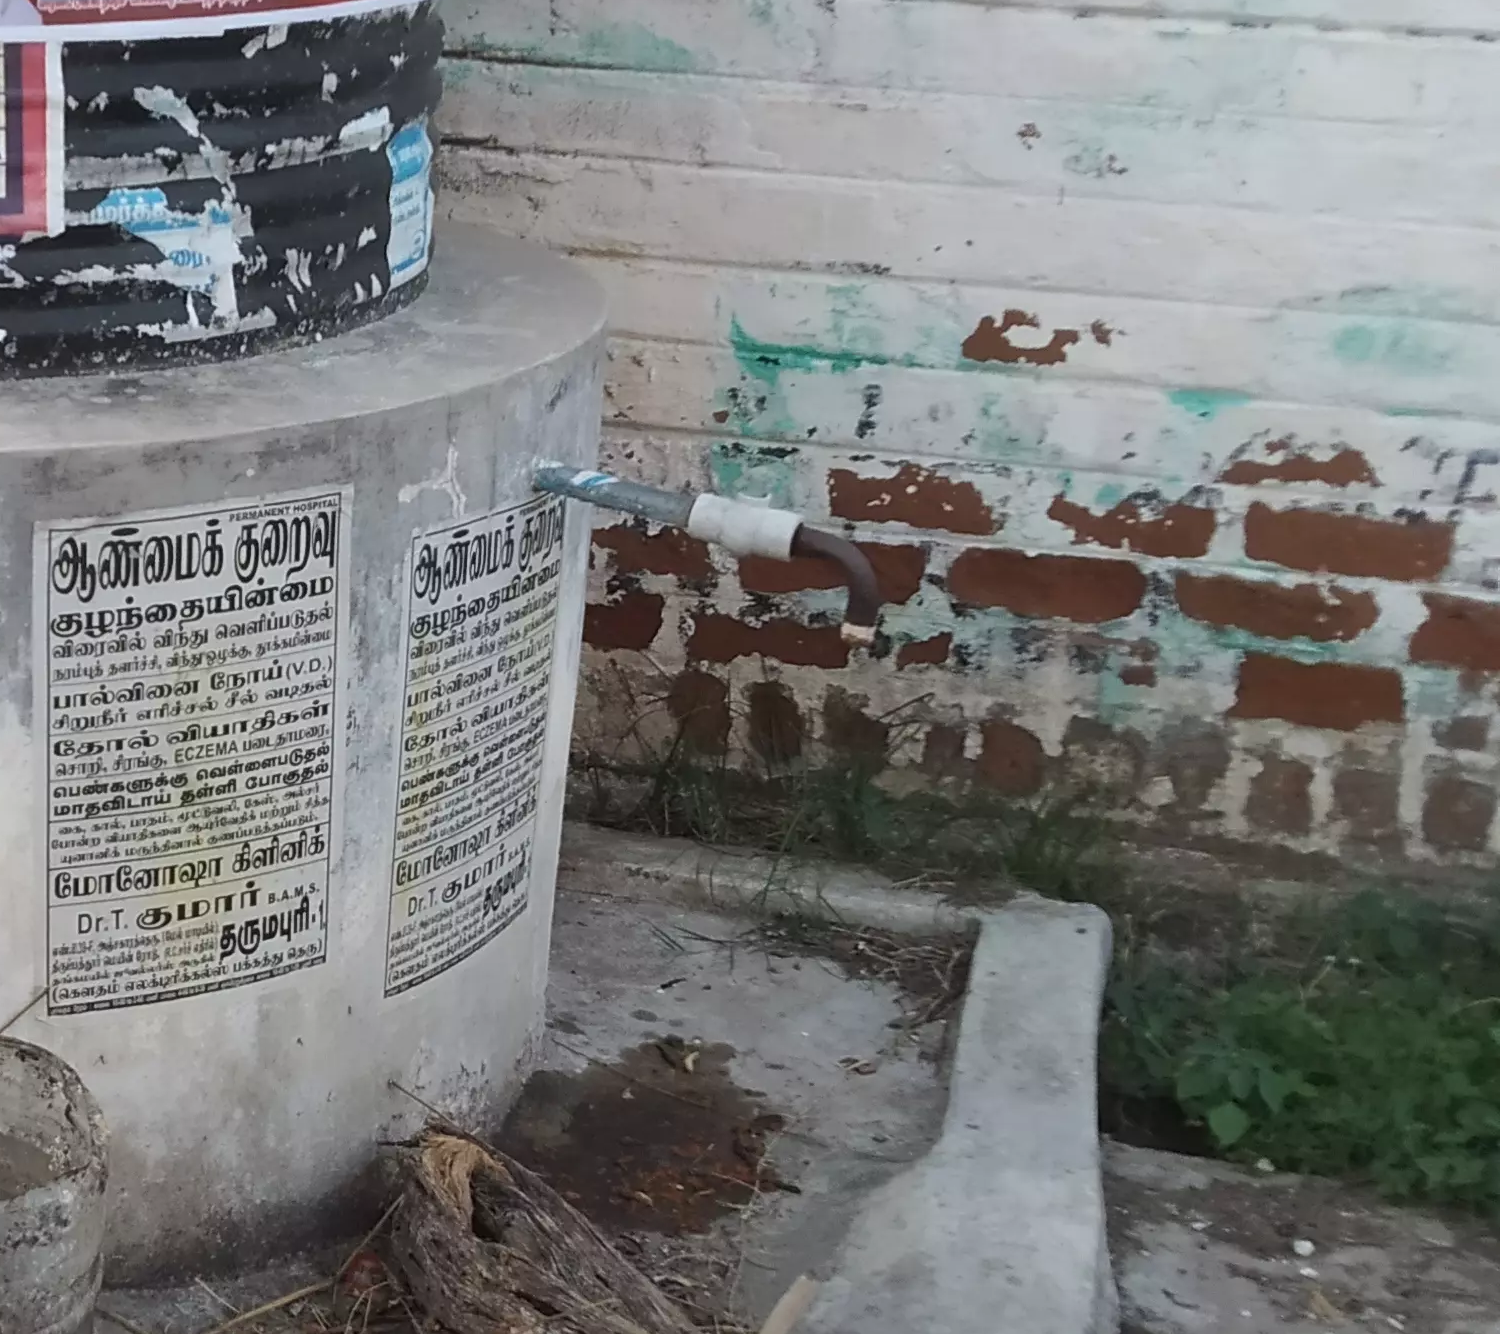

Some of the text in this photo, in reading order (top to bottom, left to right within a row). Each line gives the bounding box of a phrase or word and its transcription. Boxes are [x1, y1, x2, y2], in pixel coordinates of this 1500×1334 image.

[230, 498, 338, 522] PERMANENT HOSPITAL
[52, 510, 337, 603] ஆண்மைக் குறைவு
[414, 515, 514, 605] ஆண்மைக்
[51, 575, 334, 637] குழந்தையின்மை
[411, 559, 561, 639] குழந்தையின்மை
[52, 600, 333, 658] விரைவில் விந்து வெளிப்படுதல்
[52, 707, 128, 732] சிறுநீர்
[136, 696, 218, 721] எரிச்சல்
[265, 674, 332, 700] வடிதல்
[53, 655, 332, 709] பால்வினை நோய் (V.D.)
[407, 665, 492, 707] பால்வினை
[53, 699, 330, 759] தோல் வியாதிகள்
[174, 739, 239, 764] ECZEMA
[404, 716, 467, 752] தோல்
[53, 741, 330, 798] பெண்களுக்கு வெள்ளைபடுதல்
[53, 759, 329, 818] மாதவிடாய் தள்ளி போகுதல்
[54, 825, 325, 899] மோனோஷா கிளினிக்
[442, 843, 508, 903] குமார்
[136, 881, 262, 931] குமார்
[268, 882, 320, 904] B.A.M.S.
